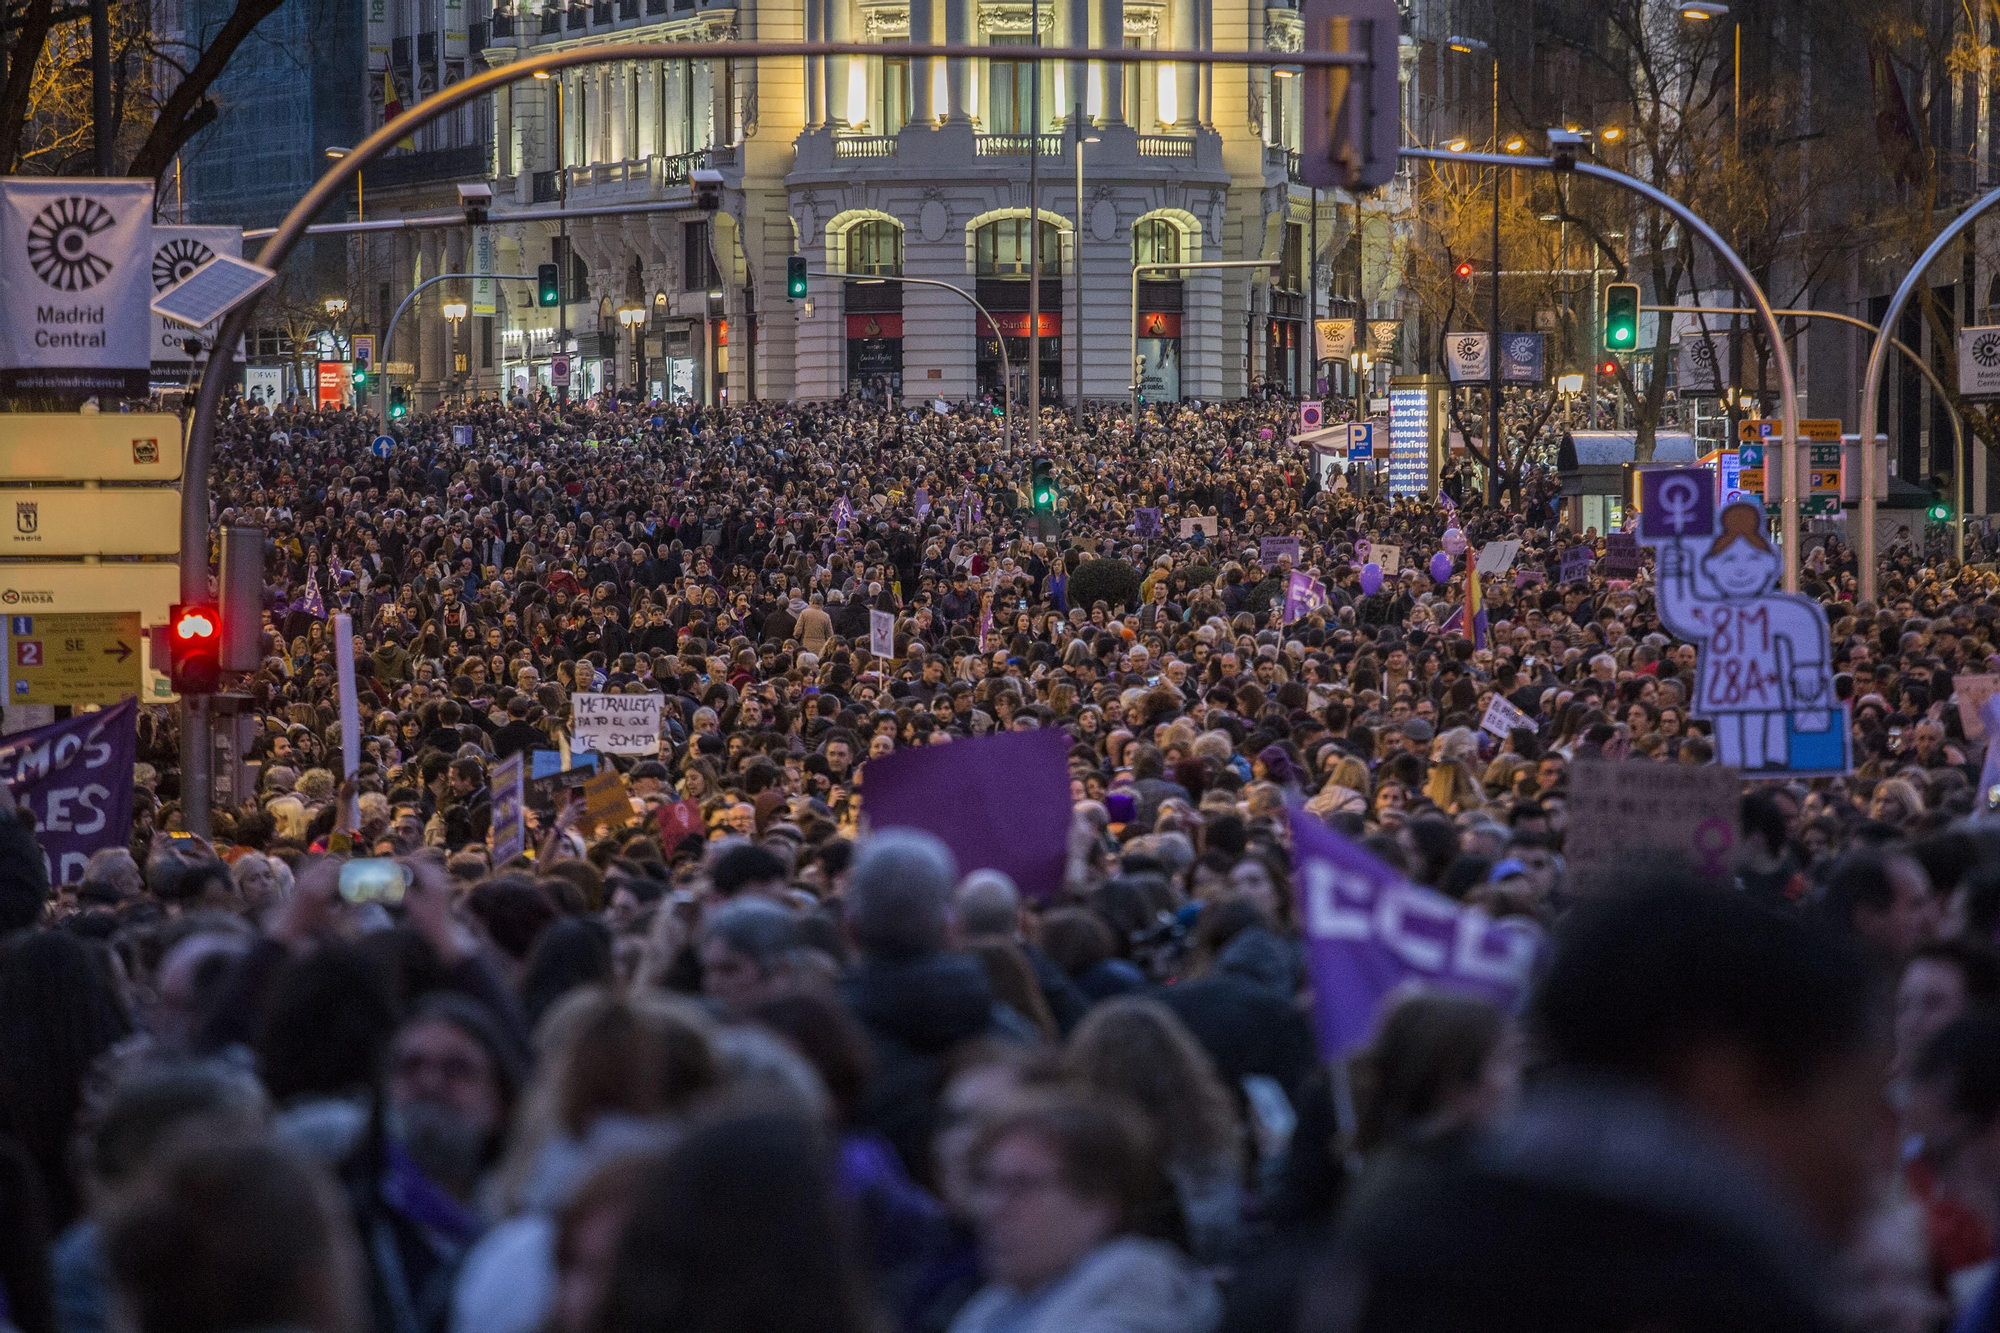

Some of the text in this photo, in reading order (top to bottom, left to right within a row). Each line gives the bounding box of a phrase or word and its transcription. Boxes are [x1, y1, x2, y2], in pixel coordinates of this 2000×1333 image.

[478, 237, 489, 270] salida
[37, 305, 104, 324] Madrid
[1002, 320, 1050, 329] Santaer
[35, 328, 106, 348] Central
[1350, 425, 1367, 450] P
[1810, 429, 1838, 437] Sevilla
[21, 595, 54, 604] MOSA
[1712, 606, 1768, 654] 8M
[65, 639, 85, 650] SE
[22, 643, 38, 664] 2
[579, 697, 657, 714] METRALLETA
[578, 716, 590, 726] PA
[594, 716, 607, 725] TO
[612, 716, 625, 727] EL
[579, 733, 656, 748] TE SOMETA
